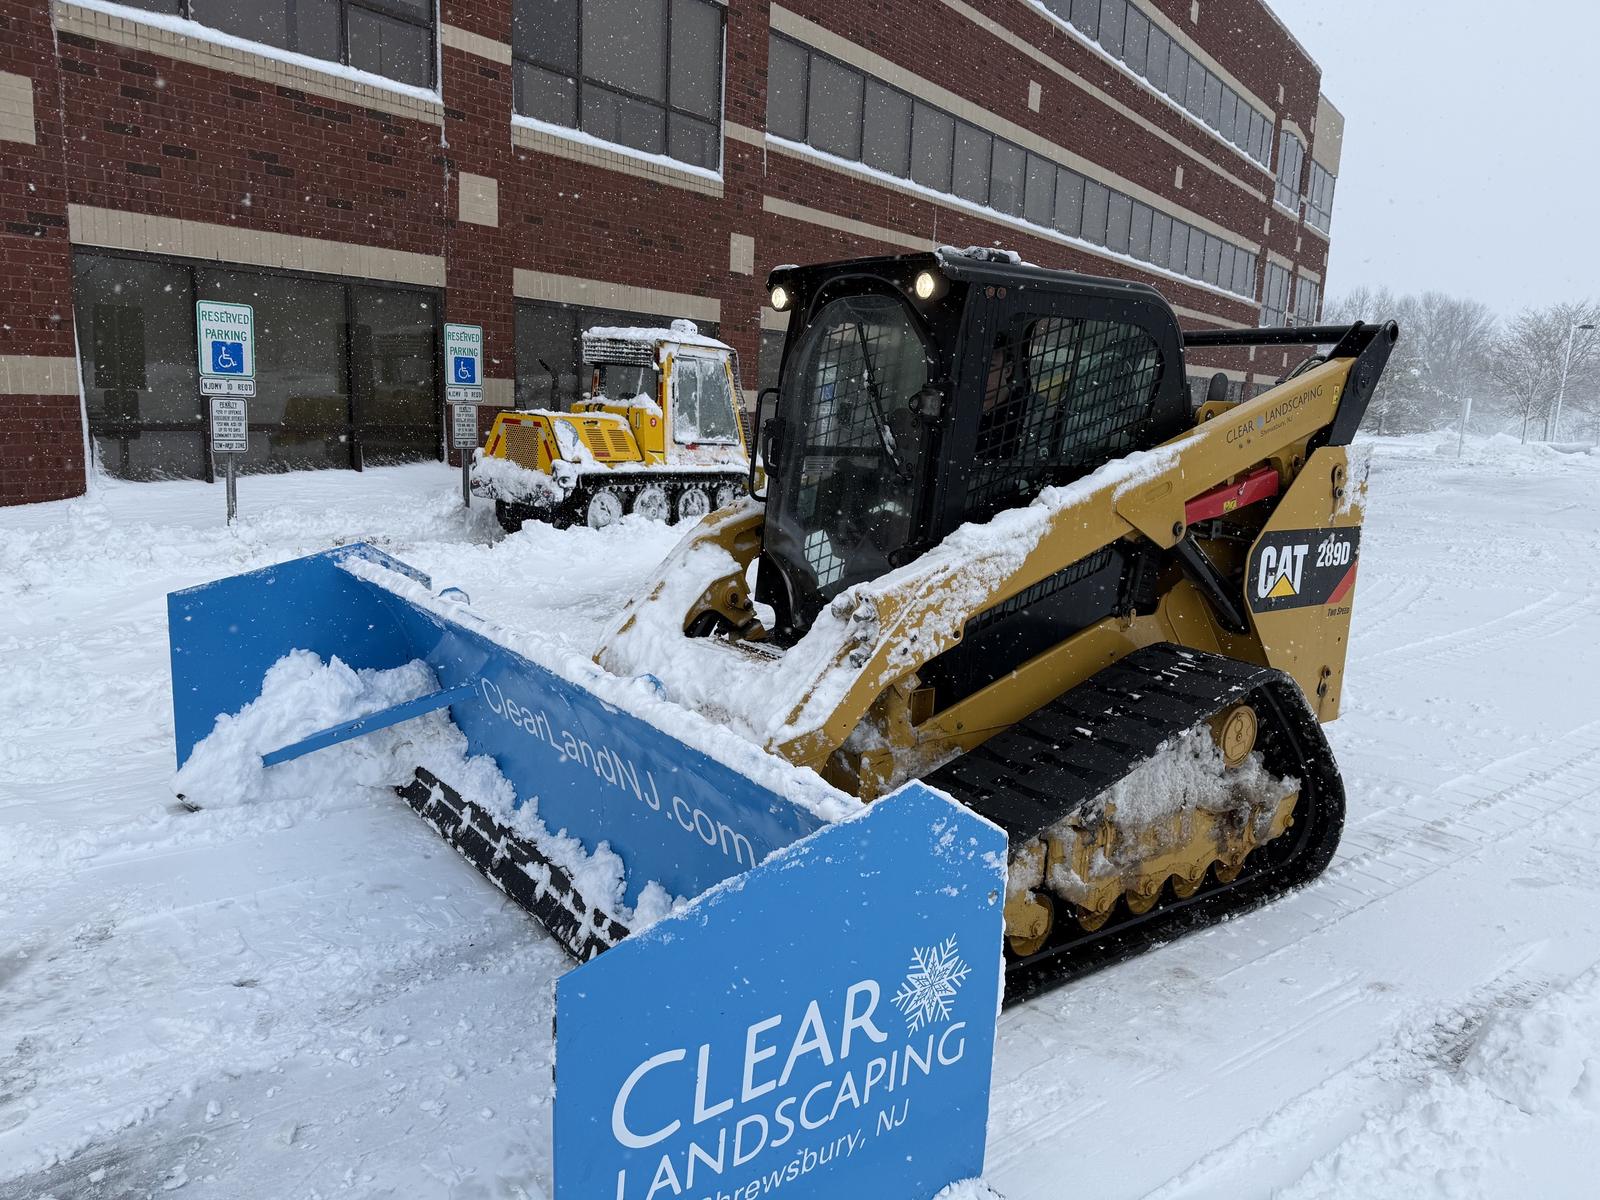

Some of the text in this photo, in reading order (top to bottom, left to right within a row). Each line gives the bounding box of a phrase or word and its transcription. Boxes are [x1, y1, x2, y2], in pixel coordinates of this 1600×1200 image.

[201, 310, 249, 325] RESERVED
[205, 328, 247, 341] PARKING
[447, 331, 480, 343] RESERVED
[449, 346, 478, 357] PARKING
[1226, 384, 1323, 444] CLEAR LANDSCAPING
[1257, 541, 1351, 599] CAT 289D
[481, 677, 756, 868] ClearLandNJ.com
[612, 979, 888, 1149] CLEAR
[700, 1098, 909, 1200] rewsbury, NJ
